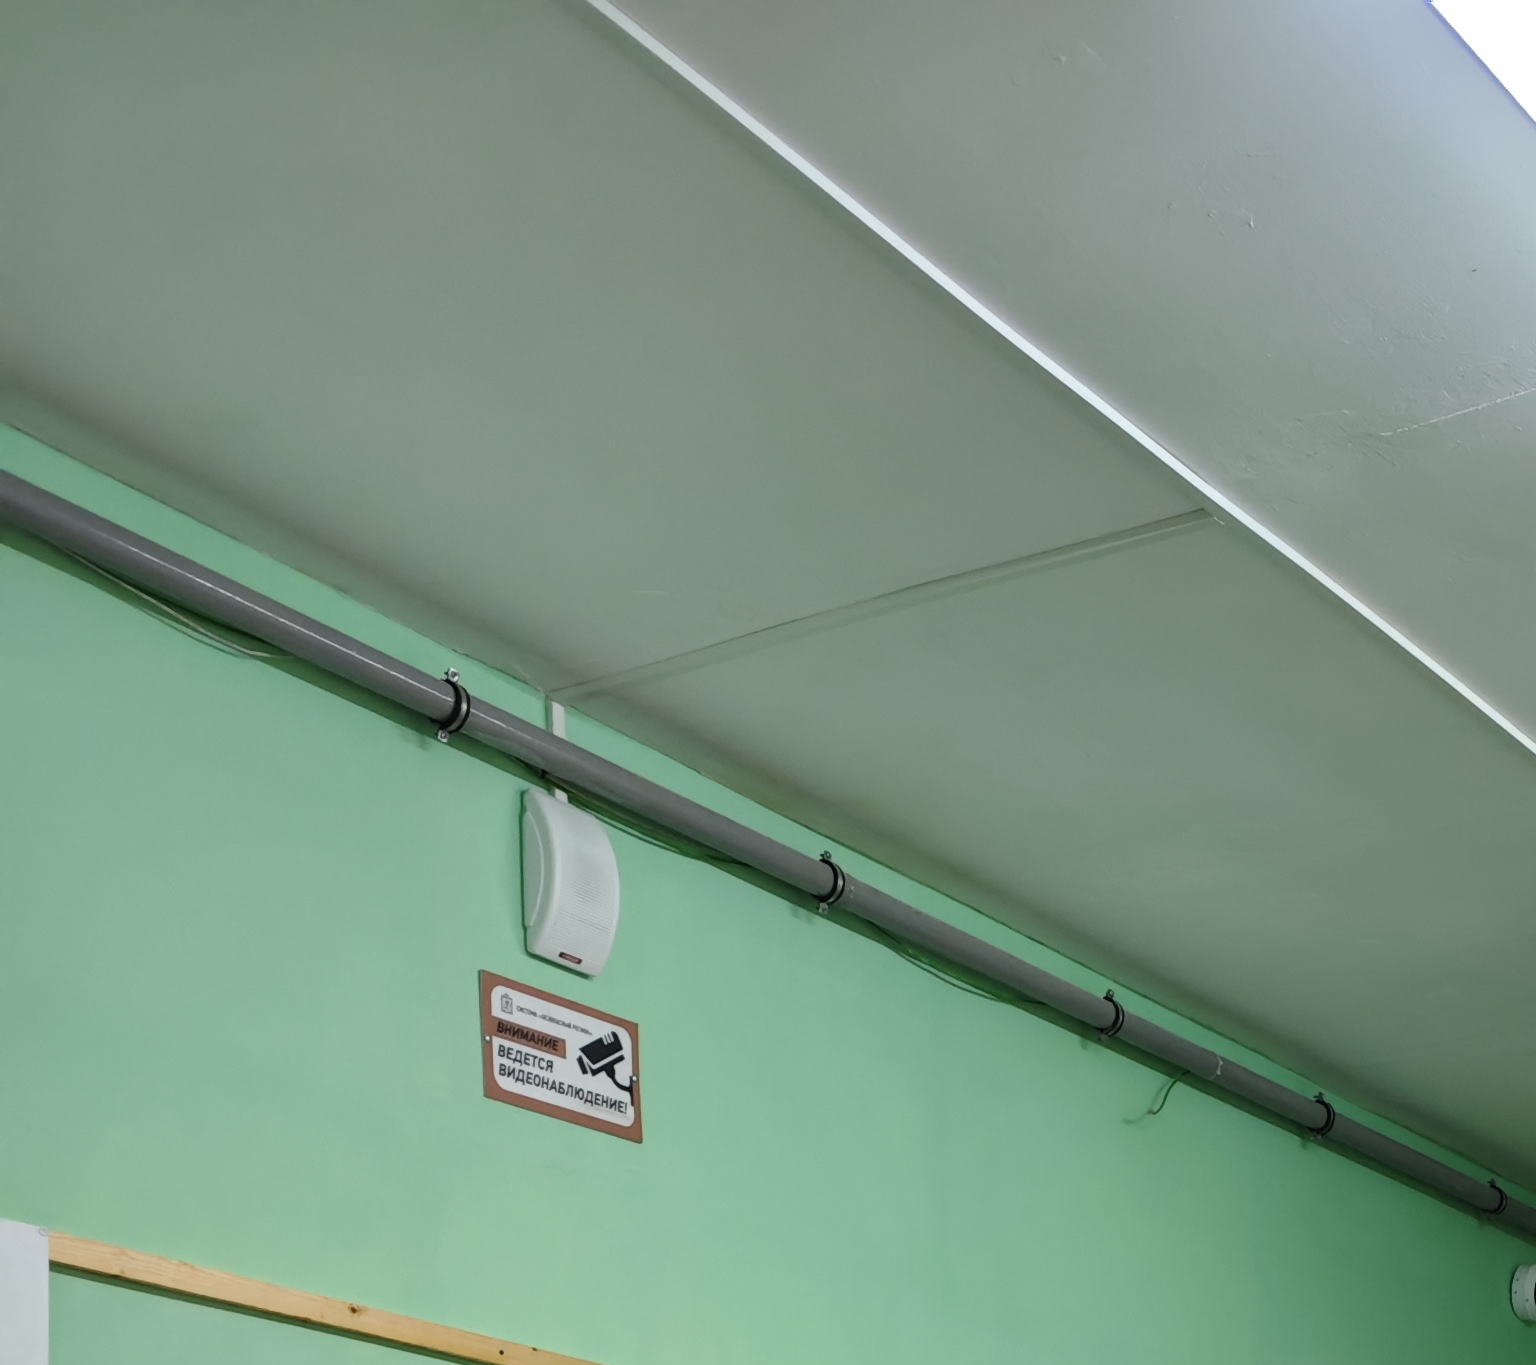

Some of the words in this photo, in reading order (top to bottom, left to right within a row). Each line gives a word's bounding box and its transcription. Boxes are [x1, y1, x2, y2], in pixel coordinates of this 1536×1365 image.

[496, 1021, 559, 1052] ВНИМАНИЕ
[498, 1044, 554, 1073] ВЕДЕТСЯ
[499, 1063, 628, 1115] ВИДЕОНАБЛЮДЕНИЕ!
